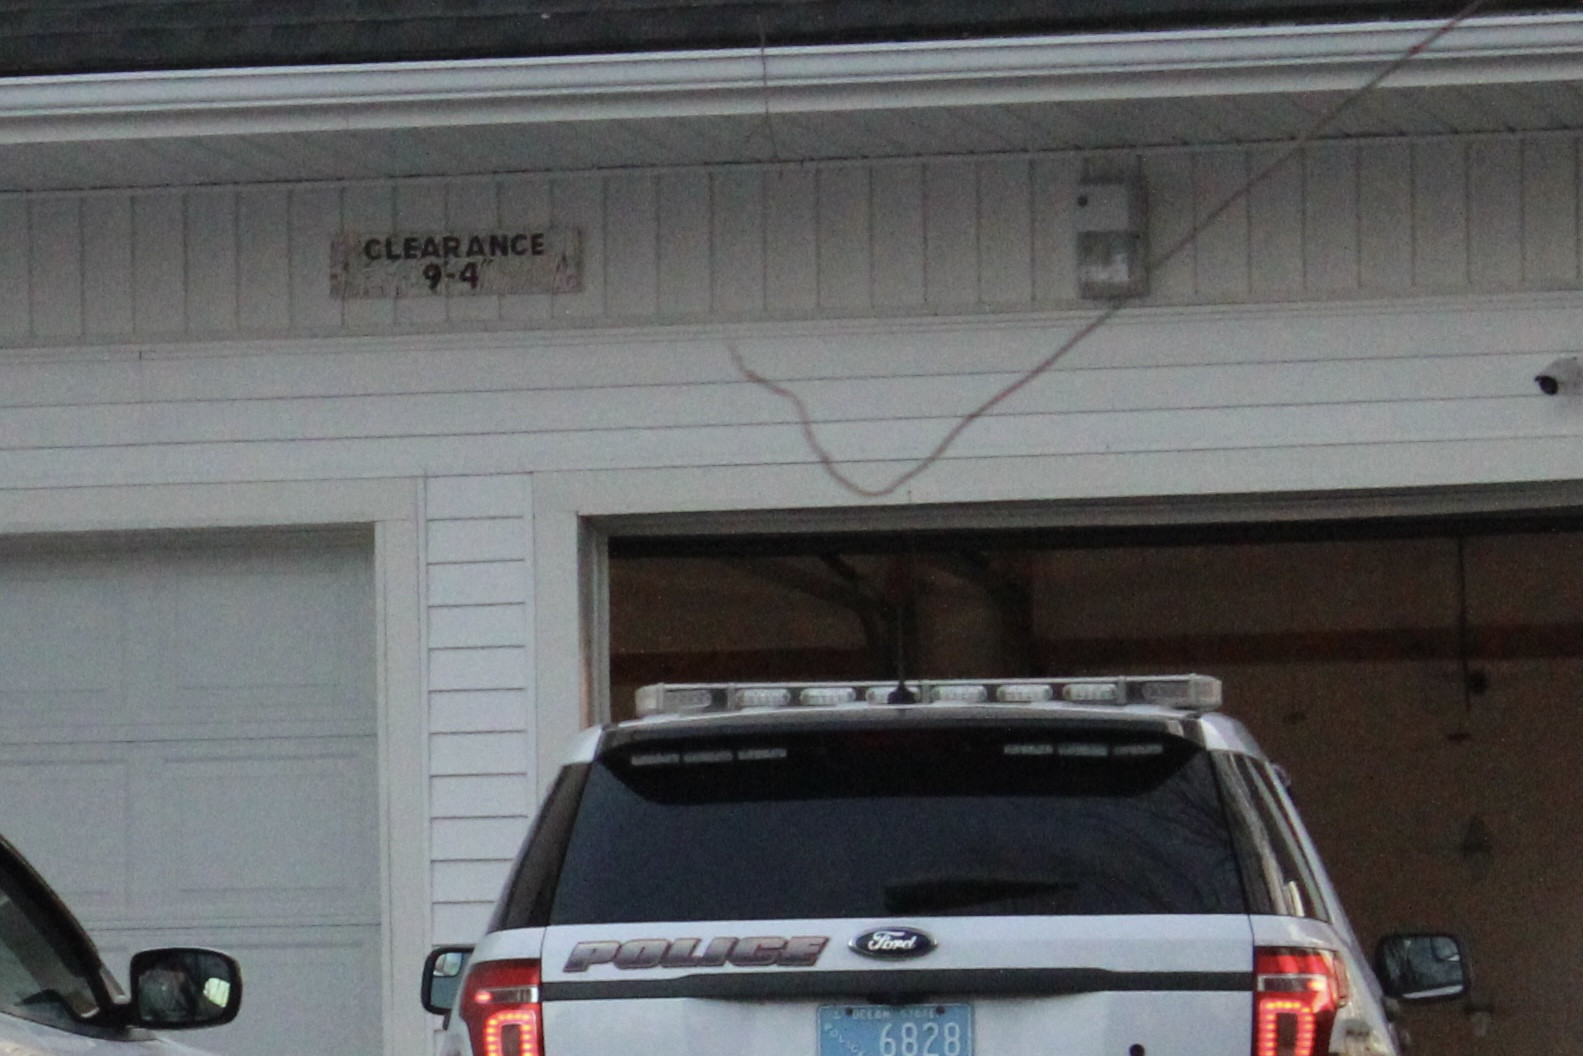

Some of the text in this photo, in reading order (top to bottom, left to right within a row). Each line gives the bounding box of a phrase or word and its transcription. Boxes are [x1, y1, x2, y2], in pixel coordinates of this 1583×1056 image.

[363, 233, 545, 260] CLEARANCE
[868, 930, 917, 951] Ford
[563, 936, 830, 973] POLICE
